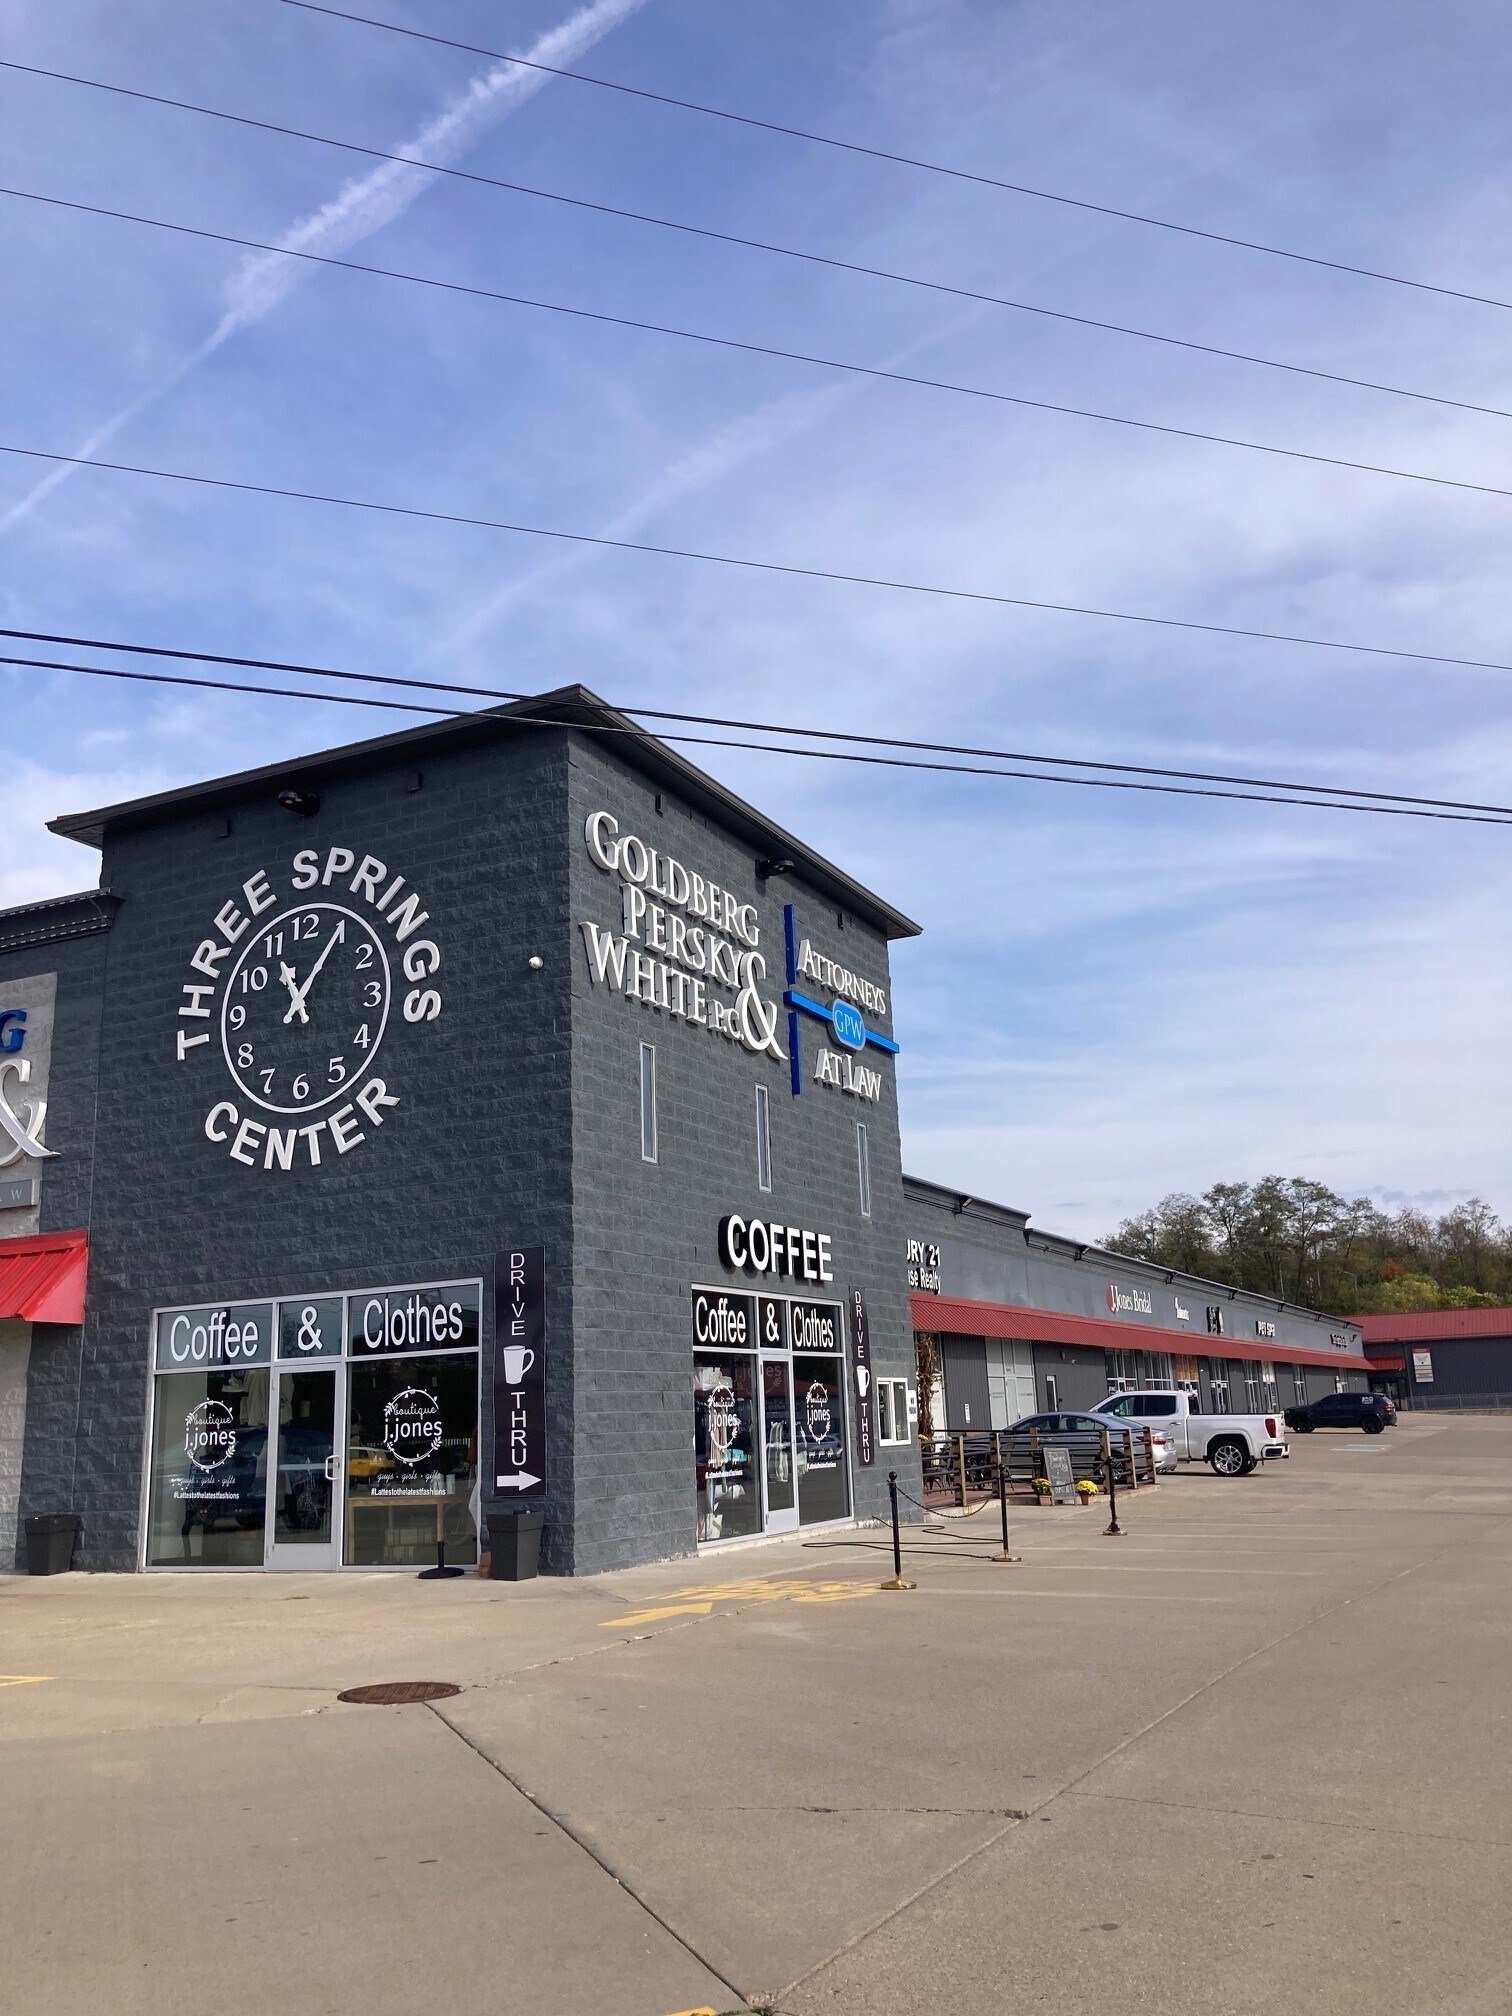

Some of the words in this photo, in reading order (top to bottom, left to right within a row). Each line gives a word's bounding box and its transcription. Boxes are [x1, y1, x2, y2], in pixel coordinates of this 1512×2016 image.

[586, 811, 760, 947] GOLDBERG
[291, 914, 320, 940] 12
[177, 869, 278, 1061] THREE
[291, 847, 442, 1024] SPRINGS
[264, 932, 284, 958] 11
[355, 943, 373, 970] 2
[239, 966, 268, 994] 10
[579, 921, 707, 1026] WHITE
[621, 882, 744, 989] PERSKY
[734, 950, 788, 1061] &
[797, 938, 887, 1015] ATTORNEYS
[362, 981, 382, 1007] 3
[229, 1005, 246, 1031] 9
[834, 1009, 864, 1041] GPW
[353, 1024, 371, 1048] 4
[237, 1043, 254, 1068] 8
[259, 1068, 275, 1094] 7
[327, 1056, 346, 1083] 5
[814, 1048, 844, 1086] AT
[843, 1052, 882, 1101] LAW
[292, 1073, 309, 1100] 6
[204, 1077, 400, 1171] CENTER
[722, 1214, 834, 1283] COFFEE
[929, 1244, 940, 1267] 21
[510, 1253, 525, 1336] DRIVE
[920, 1267, 941, 1295] Realty
[1132, 1289, 1152, 1314] Bridal
[170, 1311, 259, 1362] Coffee
[298, 1306, 323, 1351] &
[363, 1294, 463, 1349] Clothes
[696, 1296, 746, 1343] Coffee
[766, 1302, 780, 1341] &
[793, 1306, 834, 1348] Clothes
[855, 1290, 865, 1359] DRIVE
[194, 1413, 232, 1429] boutique
[393, 1402, 437, 1420] boutique
[708, 1409, 738, 1432] j.jones
[807, 1405, 830, 1425] j.jones
[184, 1427, 236, 1451] j.jones
[383, 1417, 442, 1443] j.jones
[511, 1391, 527, 1466] THRU
[861, 1403, 870, 1463] THRU
[201, 1475, 215, 1486] girls
[222, 1475, 236, 1487] gifts
[377, 1473, 394, 1483] guys
[401, 1470, 418, 1483] girls
